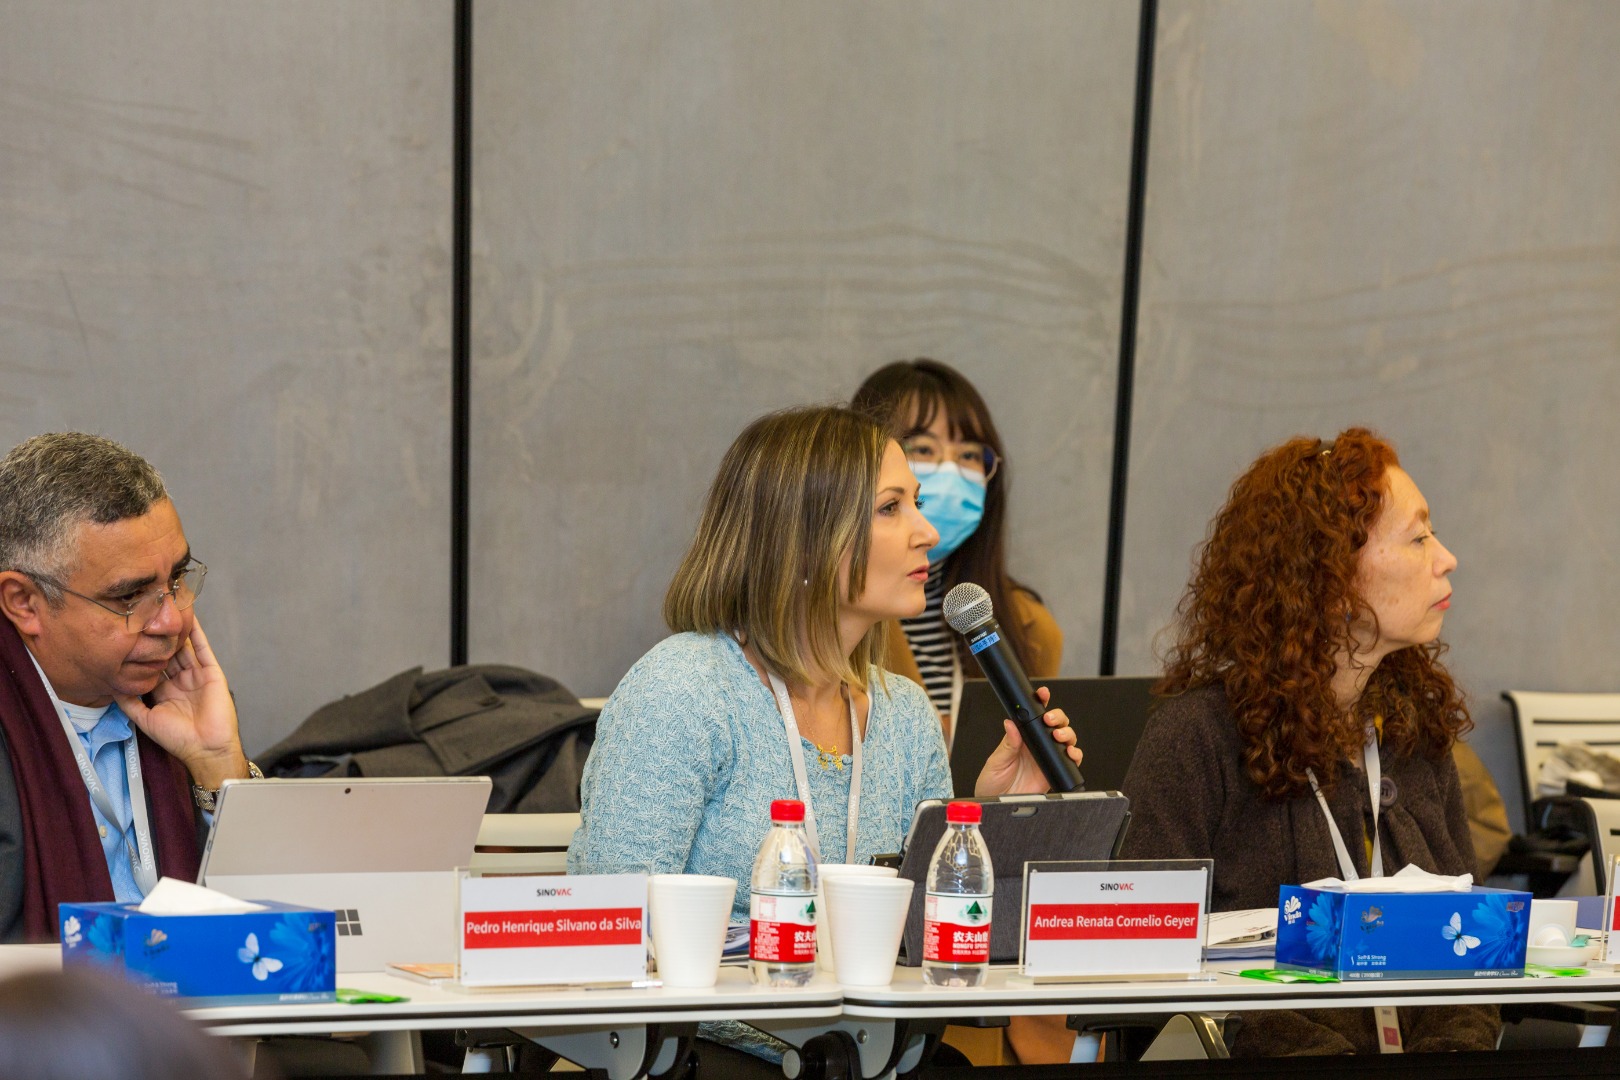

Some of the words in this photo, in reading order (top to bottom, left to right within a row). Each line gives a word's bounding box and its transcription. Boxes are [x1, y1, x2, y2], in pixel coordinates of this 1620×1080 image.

[778, 690, 796, 729] SINOVAC
[76, 753, 100, 794] SINOVAC
[800, 781, 814, 821] SINOVAC
[849, 794, 857, 832] SINOVAC
[139, 830, 152, 872] SINOVAC
[536, 888, 572, 896] SINOVAC
[467, 921, 500, 934] Pedro
[502, 920, 554, 936] Henrique
[556, 918, 597, 932] Silvano
[600, 918, 613, 931] da
[615, 916, 642, 930] Silva
[1034, 916, 1074, 928] Andrea
[1076, 915, 1114, 928] Renata
[1116, 914, 1162, 927] Cornelio
[1164, 914, 1195, 929] Geyer
